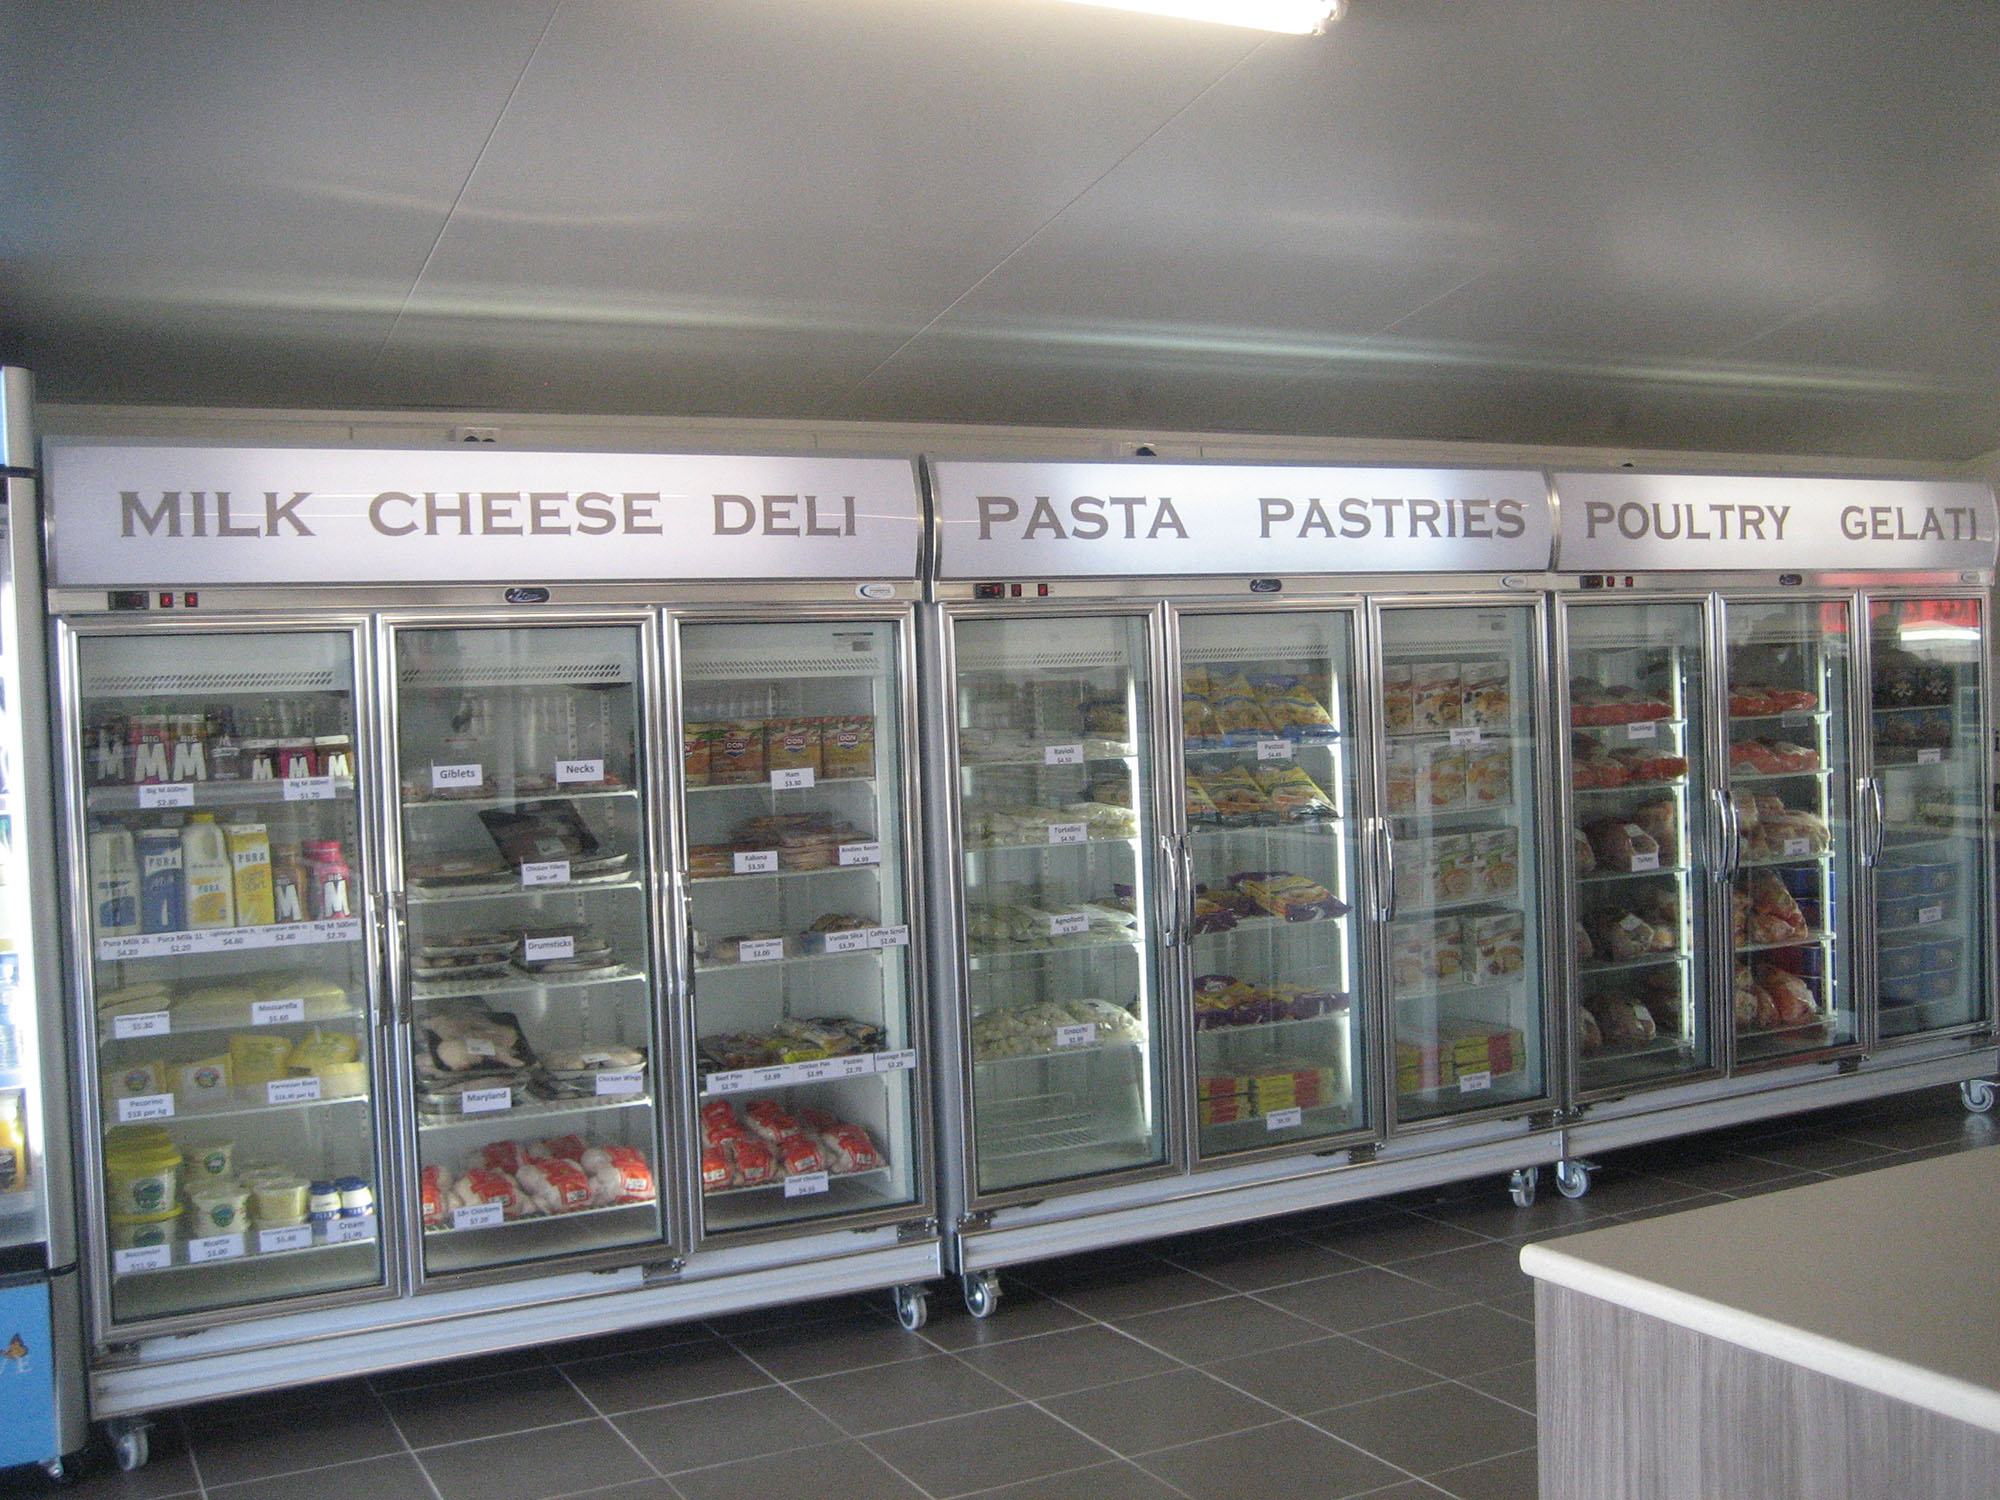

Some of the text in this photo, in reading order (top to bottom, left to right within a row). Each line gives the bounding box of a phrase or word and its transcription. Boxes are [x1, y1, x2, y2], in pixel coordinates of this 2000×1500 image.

[118, 490, 857, 538] MILK CHEESE DELI
[975, 496, 1527, 541] PASTA PASTRIES
[1586, 500, 1978, 542] POULTRY GELATI
[134, 742, 169, 782] M
[173, 742, 207, 782] M
[439, 769, 476, 779] Giblets
[566, 764, 595, 774] Necks
[324, 880, 351, 918] M
[528, 940, 572, 950] Drumsticks
[467, 1091, 507, 1102] Maryland
